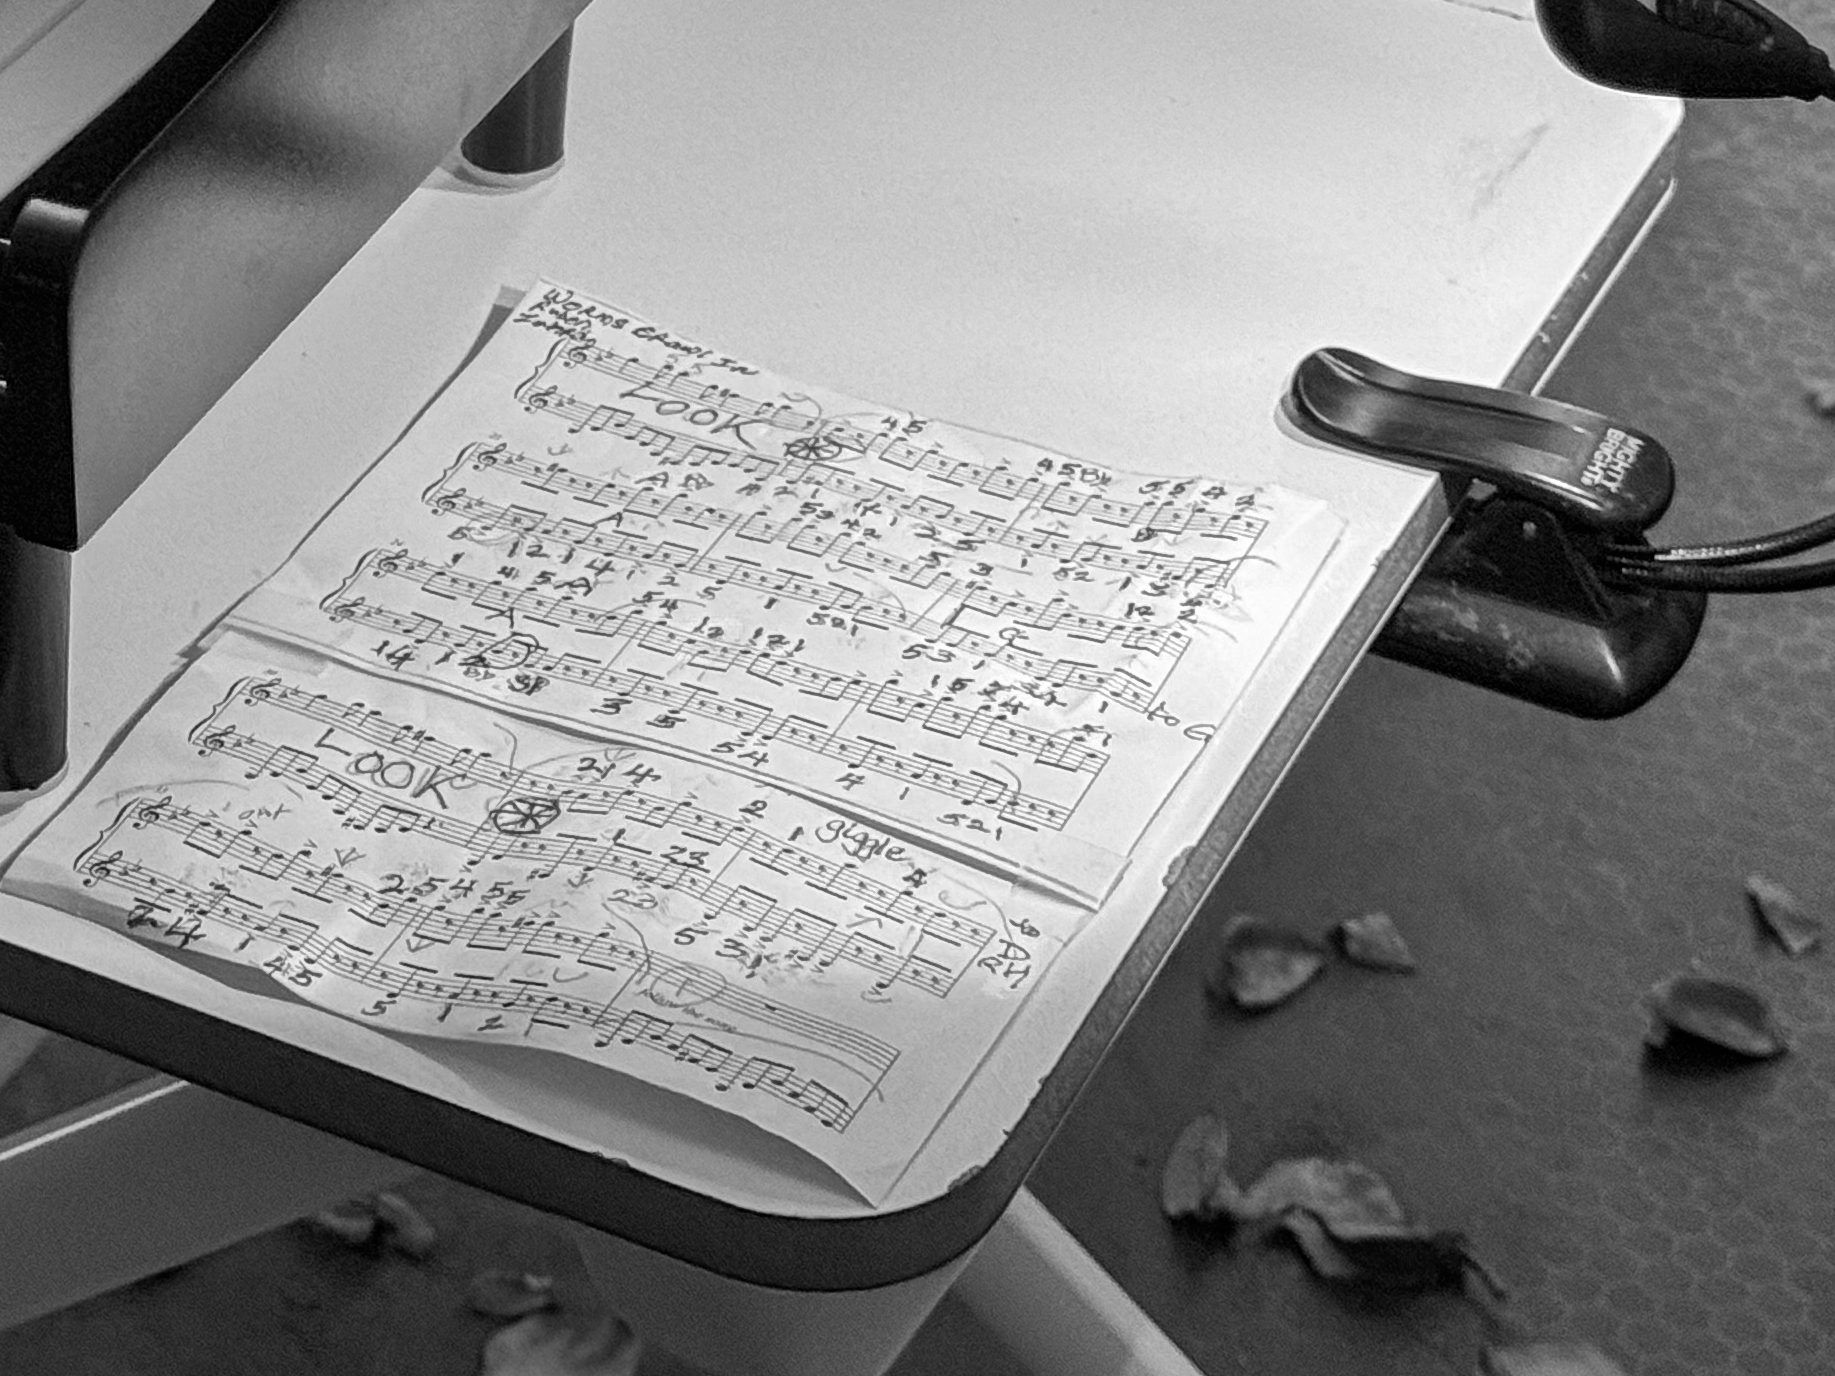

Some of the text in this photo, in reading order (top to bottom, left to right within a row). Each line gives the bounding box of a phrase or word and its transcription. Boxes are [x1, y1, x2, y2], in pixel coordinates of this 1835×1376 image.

[619, 380, 772, 450] LOOK
[1600, 435, 1645, 494] MIGHTY
[314, 727, 468, 810] LOOK
[814, 819, 912, 863] giggle
